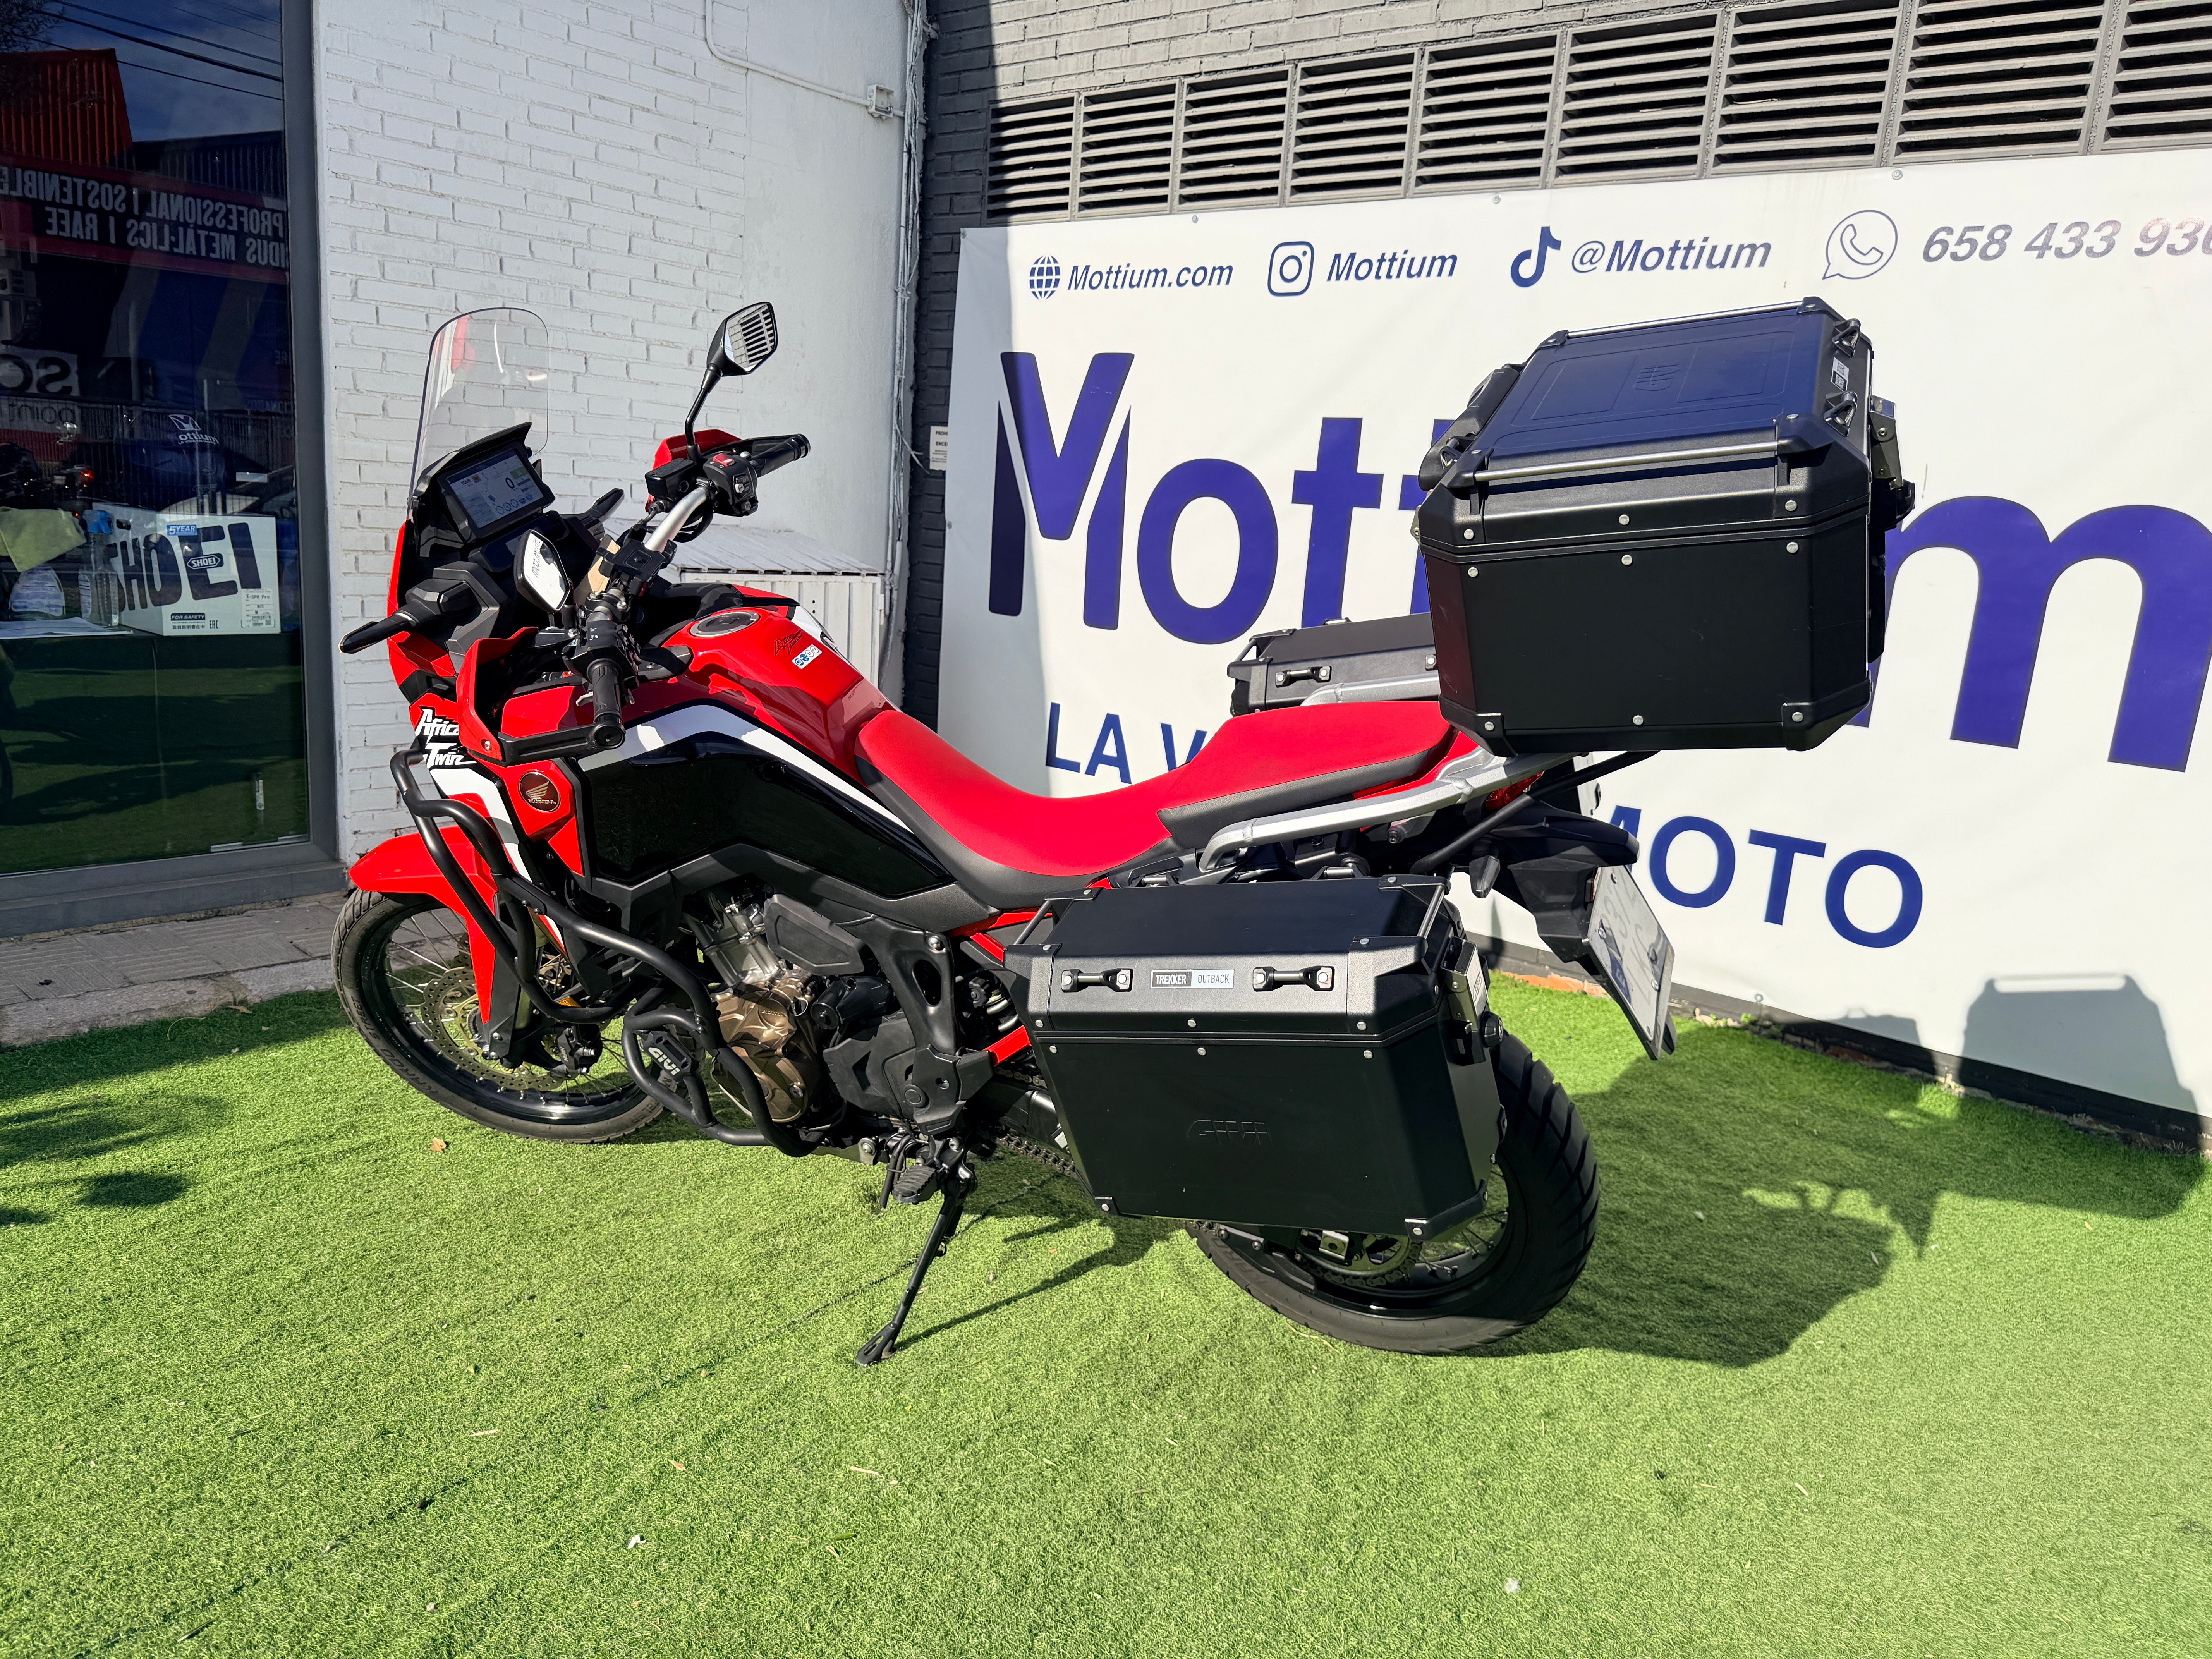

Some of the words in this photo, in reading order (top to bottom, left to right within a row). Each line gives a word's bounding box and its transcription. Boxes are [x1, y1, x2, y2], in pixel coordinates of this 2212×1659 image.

[1572, 237, 1771, 273] @Mottium
[1923, 224, 2012, 262] 658
[2023, 220, 2121, 259] 433
[1068, 263, 1233, 290] Mottium.com
[1327, 249, 1457, 282] Mottium
[505, 477, 515, 489] 0
[191, 557, 216, 567] SHOEI
[415, 709, 459, 744] Africa
[423, 742, 477, 769] Twin
[1046, 702, 1132, 784] LA
[1610, 805, 1923, 948] OTO
[1156, 974, 1187, 984] TREKKER
[1198, 974, 1229, 984] OUTBACK
[648, 1047, 680, 1076] GIVI
